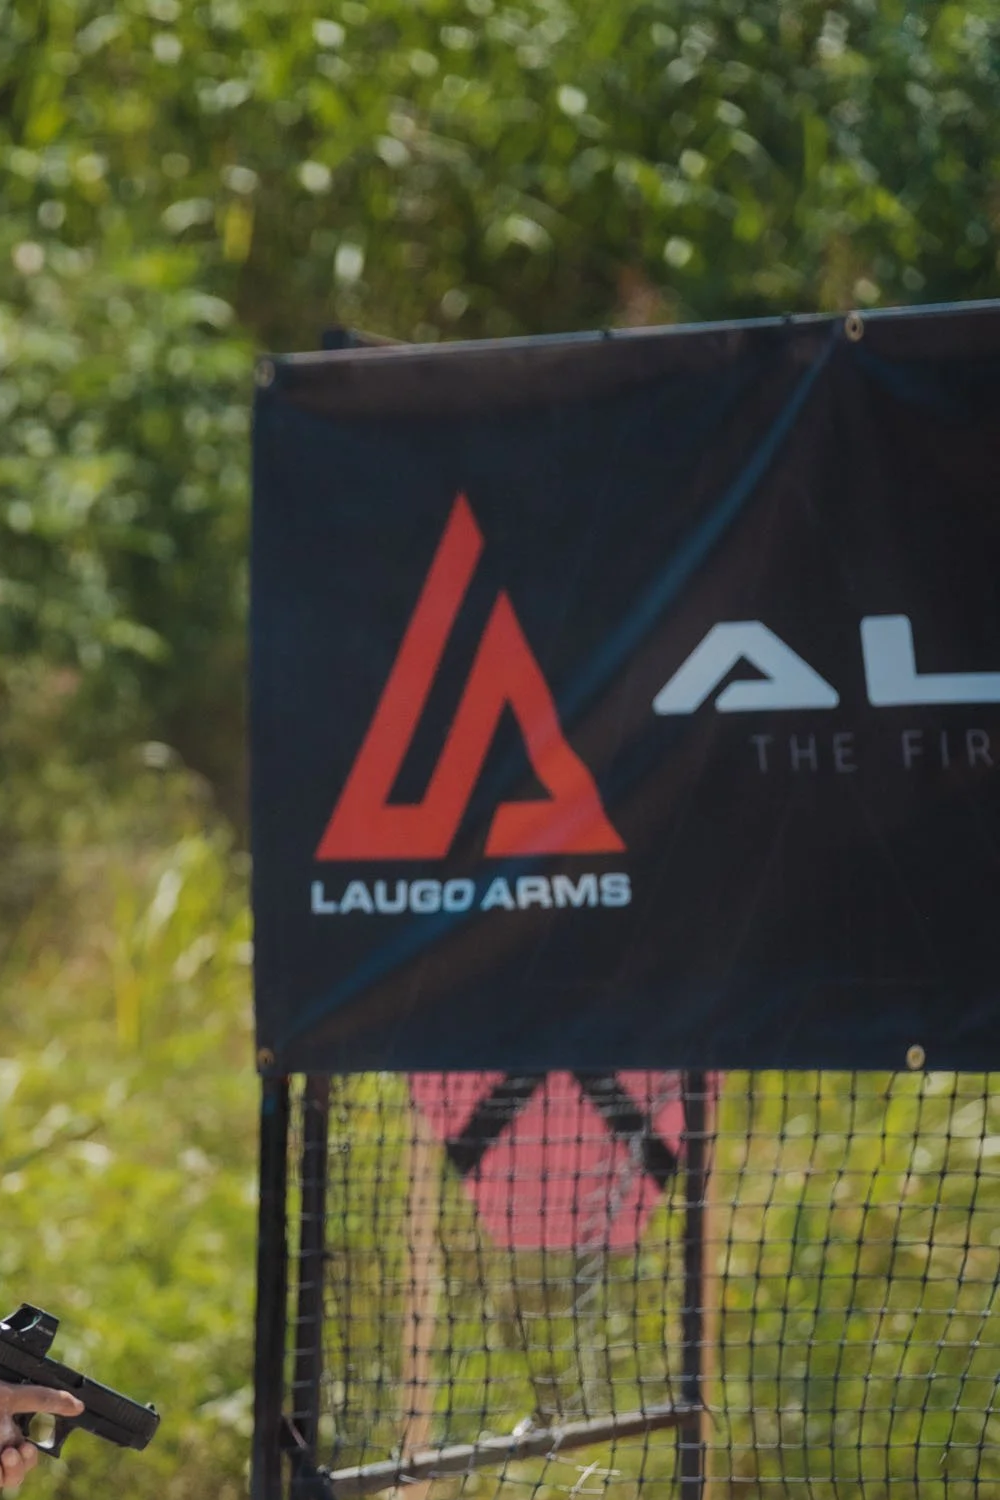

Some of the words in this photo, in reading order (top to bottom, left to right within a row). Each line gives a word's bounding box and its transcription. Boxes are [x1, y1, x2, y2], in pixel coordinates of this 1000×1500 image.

[750, 730, 858, 774] THE
[901, 728, 995, 770] FIR
[311, 879, 475, 915] LAUGO
[480, 872, 633, 911] ARMS
